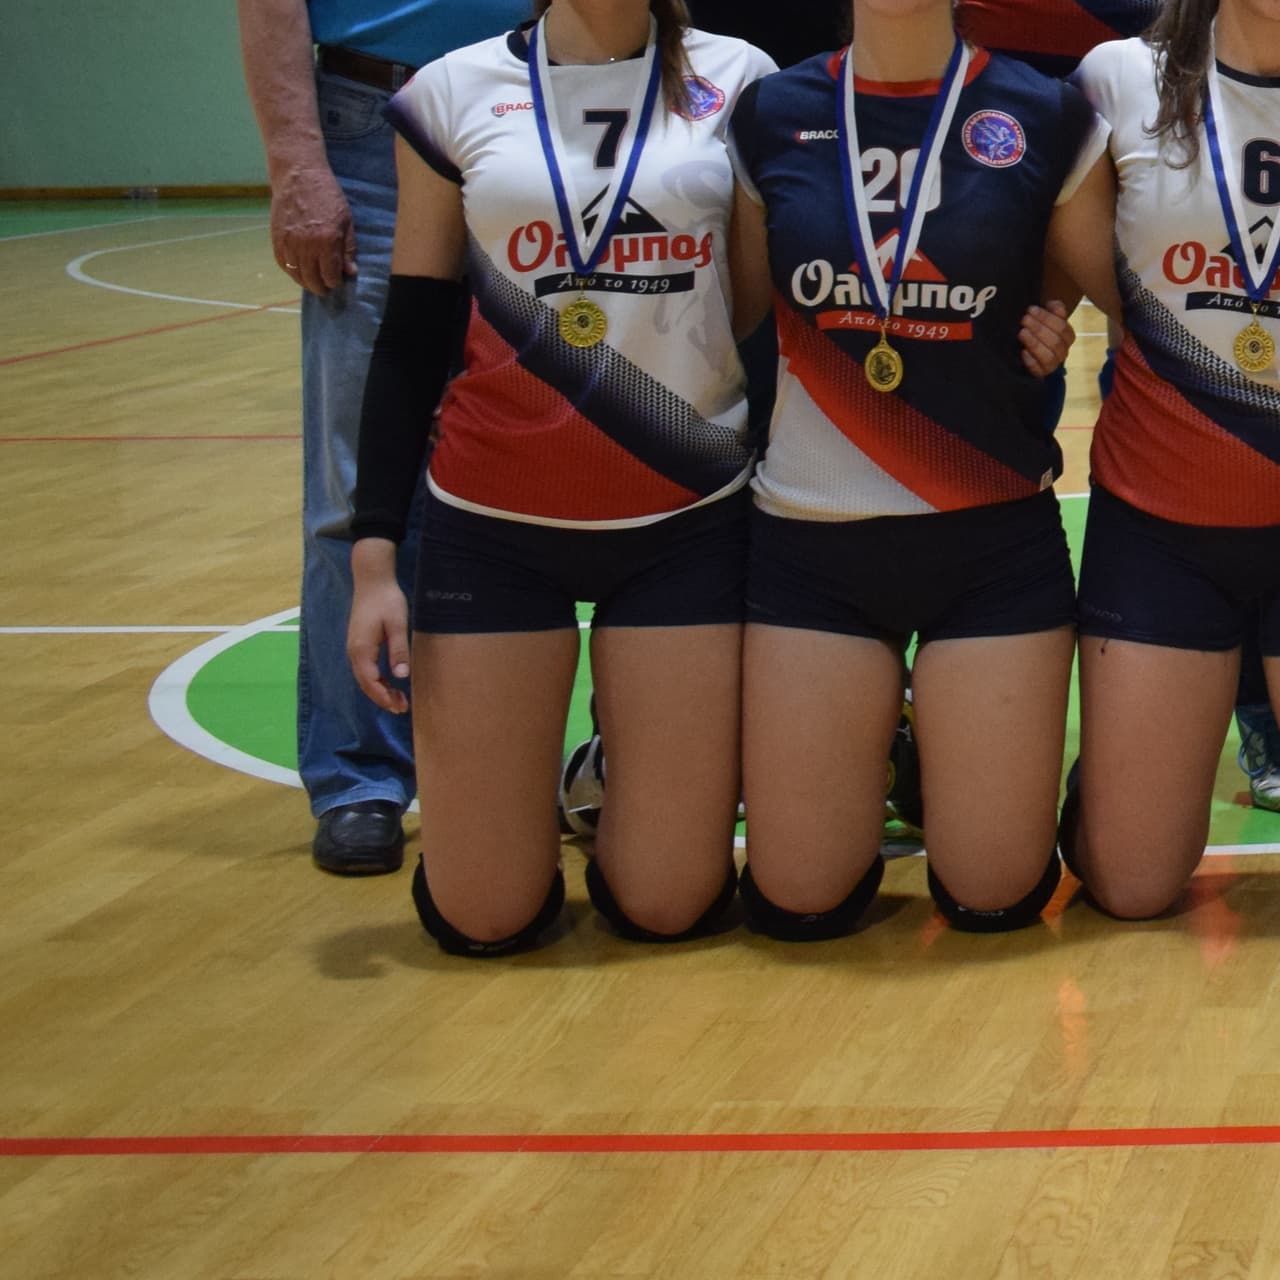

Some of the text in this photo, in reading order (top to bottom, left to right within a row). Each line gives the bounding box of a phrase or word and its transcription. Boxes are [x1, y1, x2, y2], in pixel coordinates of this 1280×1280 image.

[491, 101, 534, 117] BRAC
[582, 107, 631, 170] 7
[507, 220, 713, 273] Ολμπος
[630, 277, 671, 293] 1949
[906, 322, 950, 339] 1949
